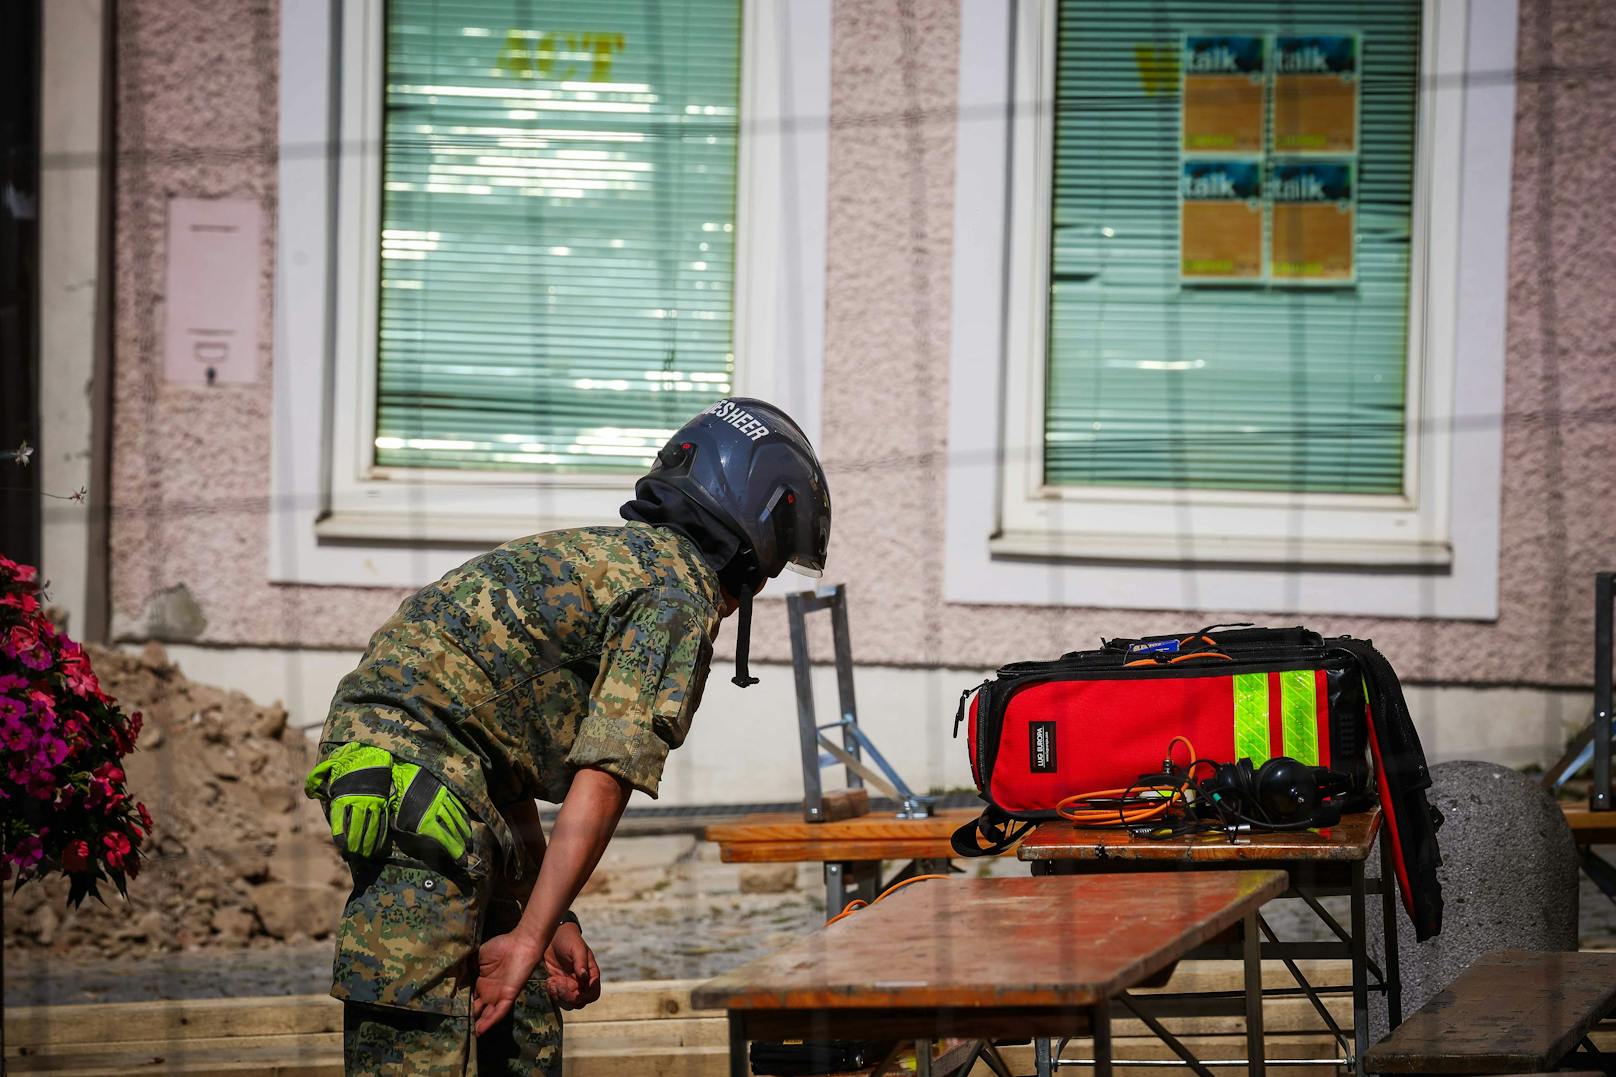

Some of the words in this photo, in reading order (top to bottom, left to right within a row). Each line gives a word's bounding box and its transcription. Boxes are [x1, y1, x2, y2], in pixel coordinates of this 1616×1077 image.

[1185, 46, 1238, 71] talk
[1275, 46, 1329, 71] talk
[1182, 171, 1236, 197] talk
[1272, 174, 1326, 199] talk
[1036, 727, 1044, 753] EUROPA
